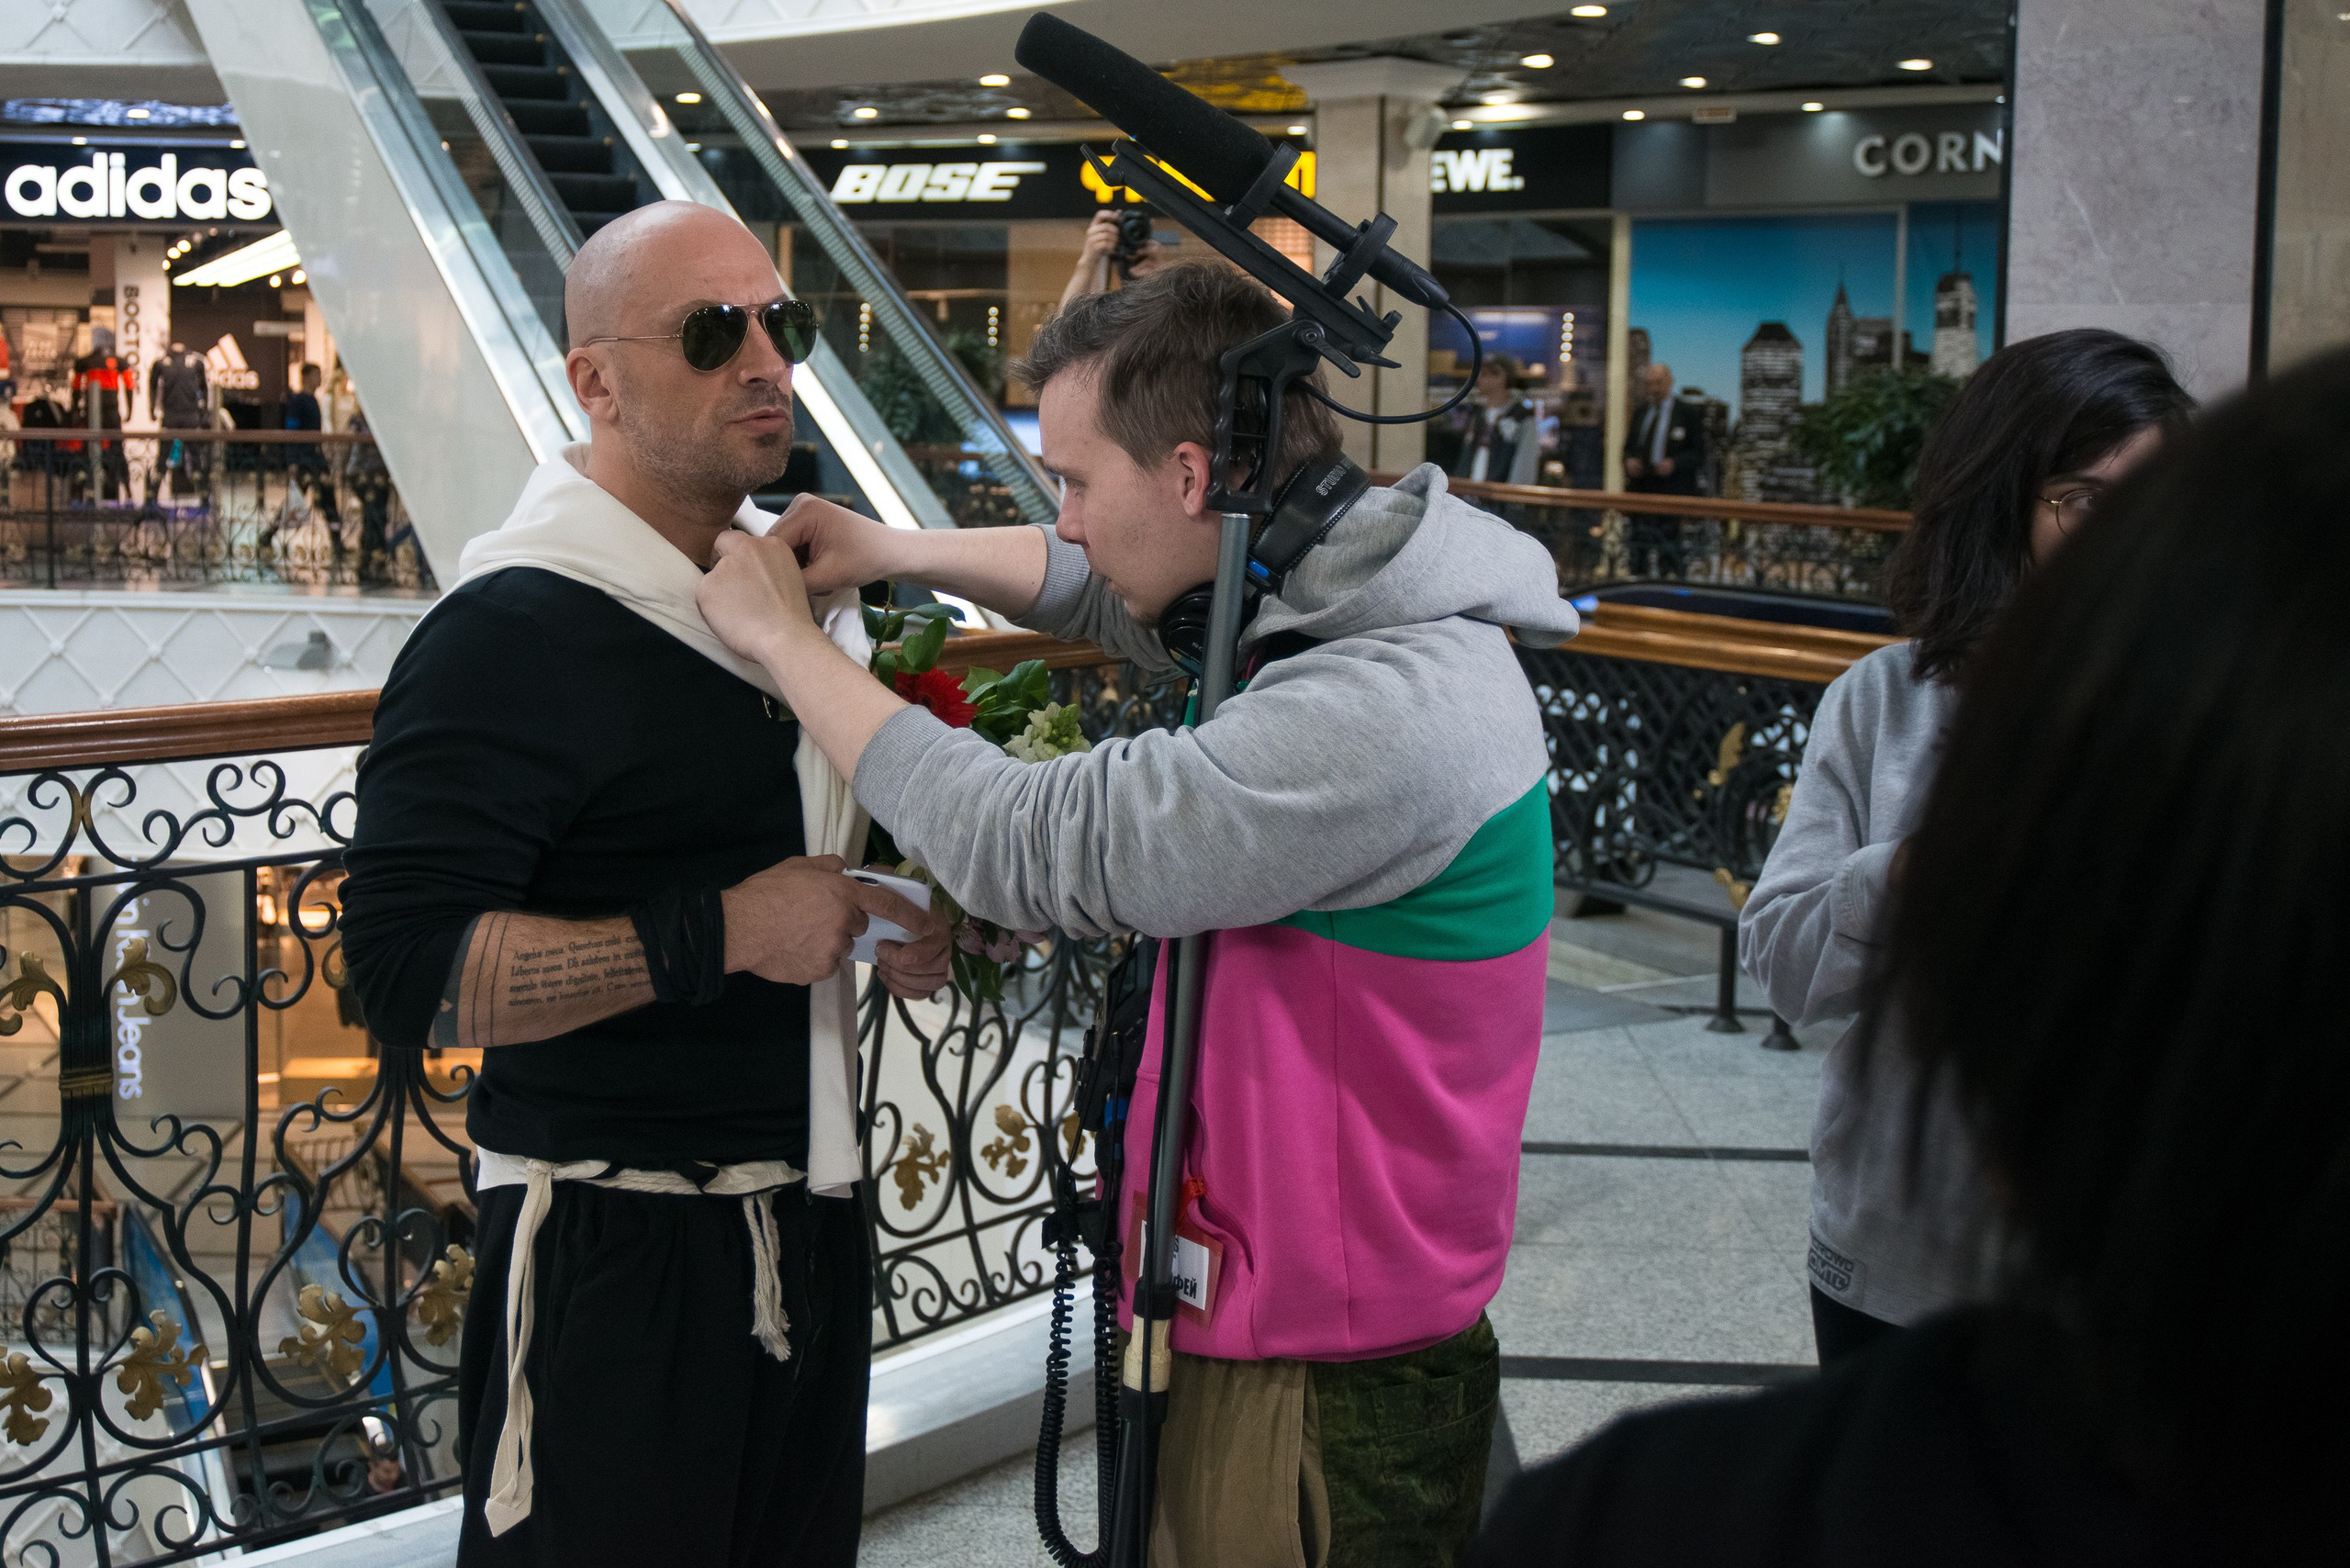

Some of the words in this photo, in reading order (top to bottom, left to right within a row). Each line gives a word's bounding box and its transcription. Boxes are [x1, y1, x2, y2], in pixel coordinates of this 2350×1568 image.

[5, 151, 273, 220] adidas
[830, 161, 1047, 204] BOSE
[1315, 465, 1347, 496] STUDIO
[510, 966, 540, 977] Liberos
[613, 952, 621, 961] in
[117, 1006, 151, 1101] Jeans
[1171, 1273, 1197, 1299] ФЕЙ
